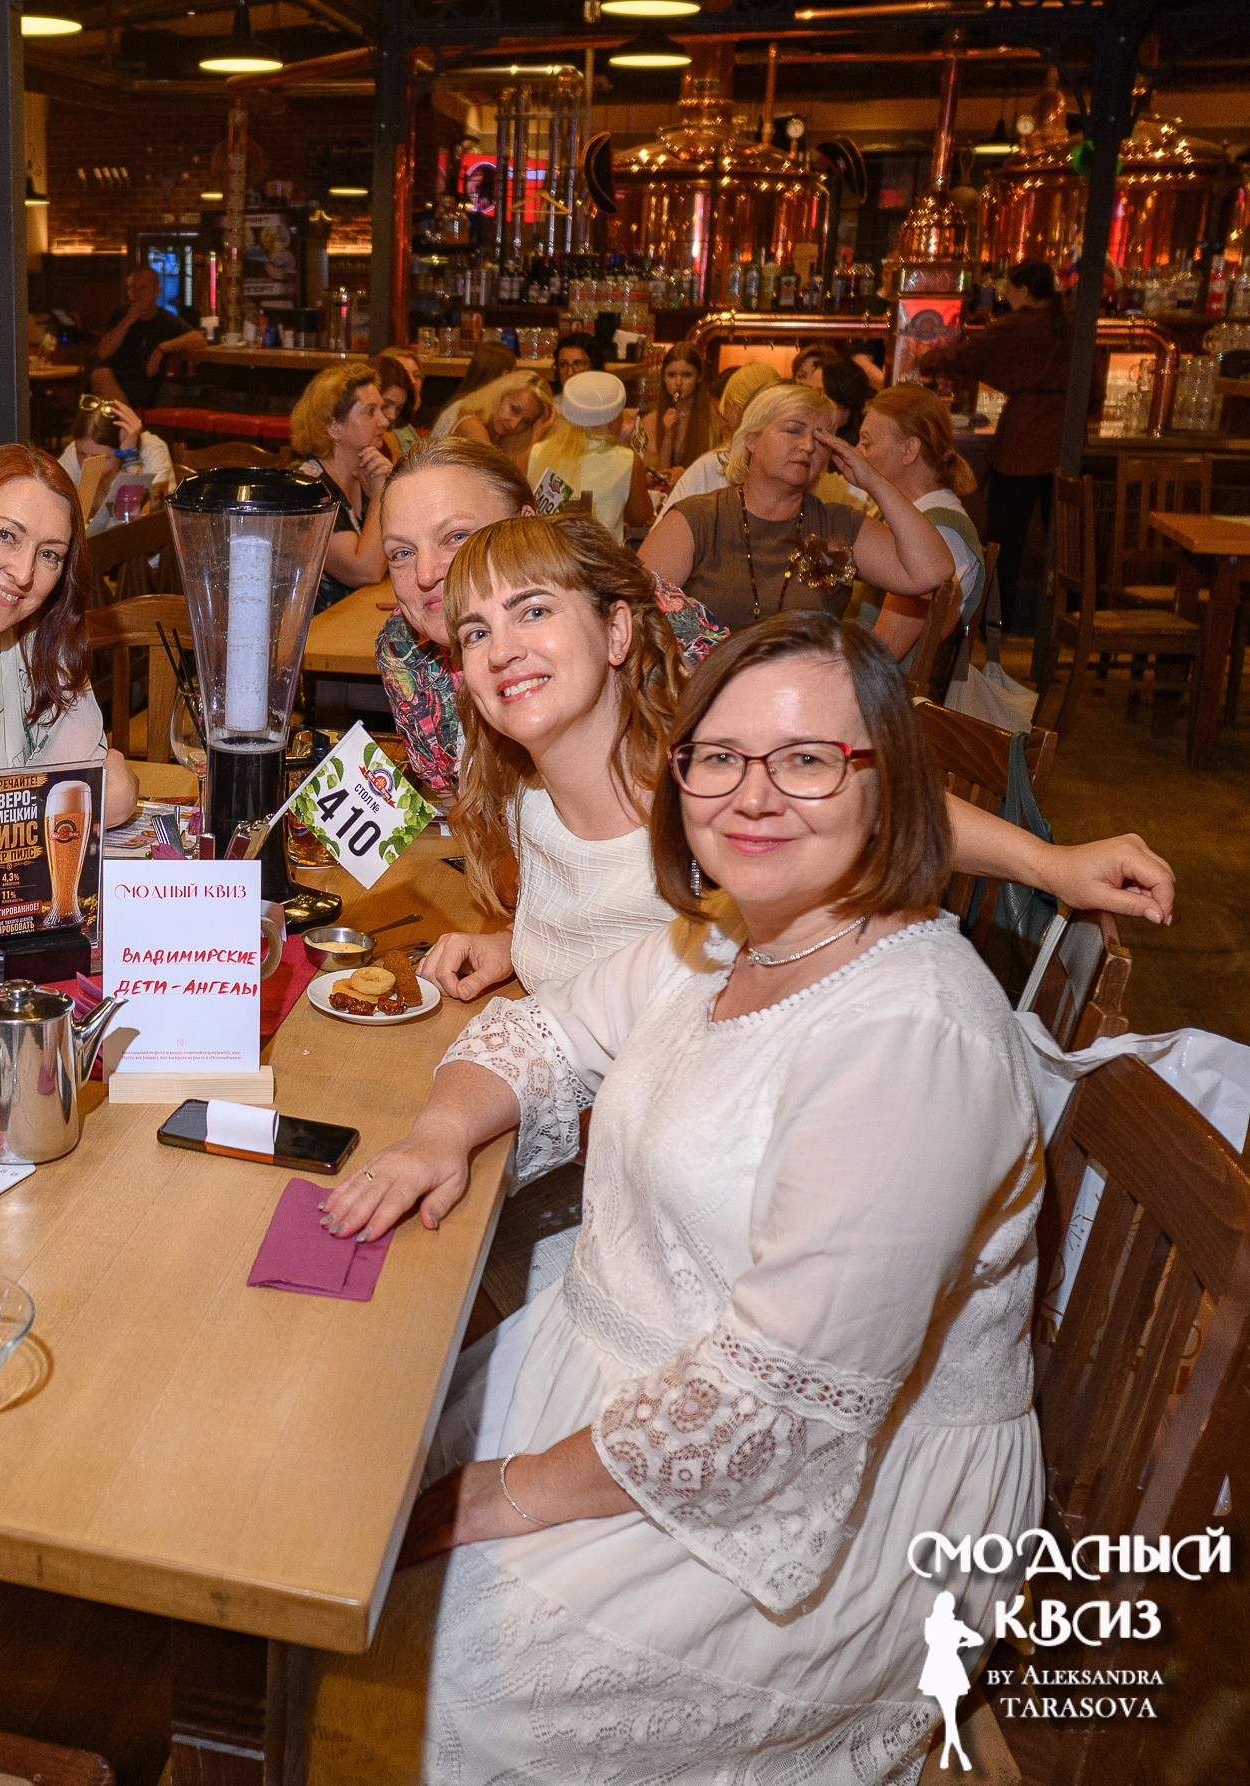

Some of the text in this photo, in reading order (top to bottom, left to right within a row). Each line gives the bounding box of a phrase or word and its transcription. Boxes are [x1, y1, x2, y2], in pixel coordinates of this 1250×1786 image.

[354, 783, 380, 813] СТОЛ №
[316, 788, 382, 857] 410
[11, 848, 35, 861] ПИЛС
[2, 872, 20, 883] 4,3%
[2, 891, 16, 900] 11%
[113, 883, 247, 900] МОДНЫЙ КВИЗ
[122, 947, 257, 966] ВЛАДИМИРСКИЕ
